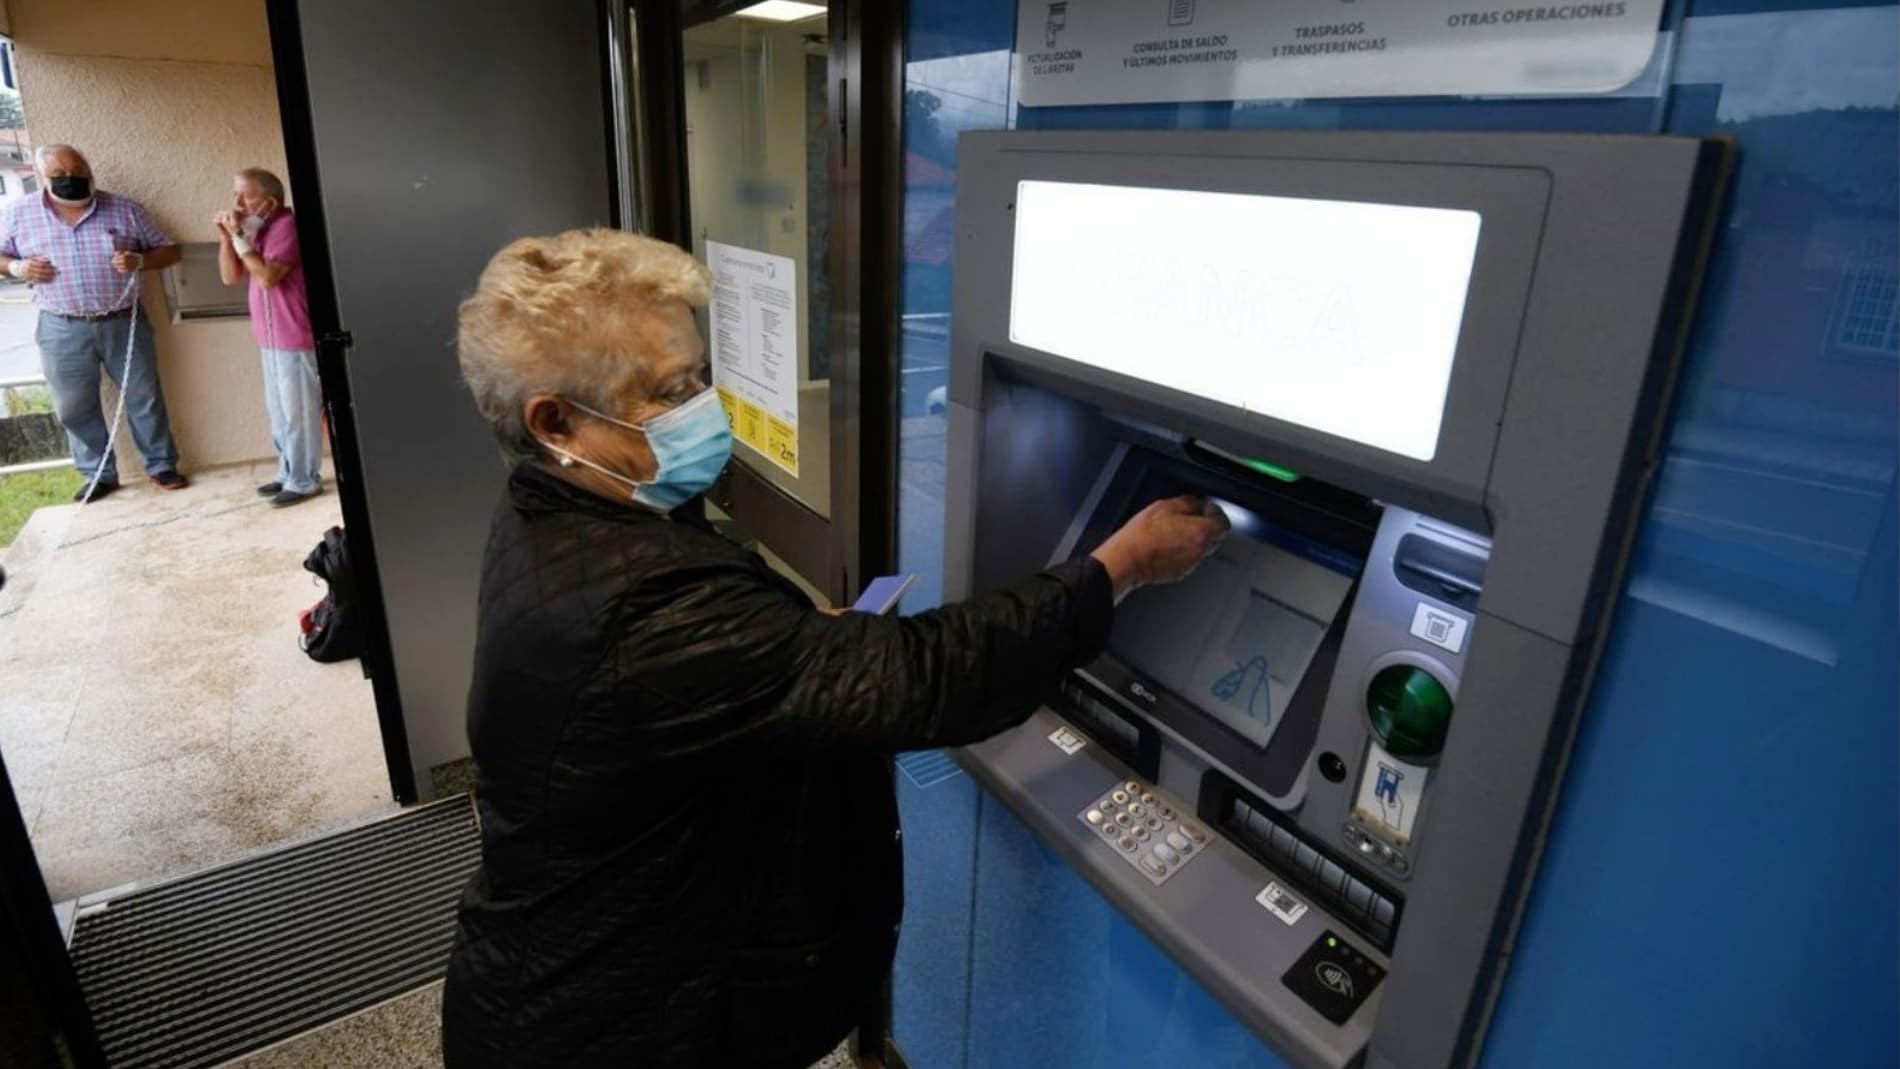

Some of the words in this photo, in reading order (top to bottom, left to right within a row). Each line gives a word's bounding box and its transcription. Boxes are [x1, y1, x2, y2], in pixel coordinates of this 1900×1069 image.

[1447, 11, 1498, 28] OTRAS
[1502, 2, 1627, 23] OPERACIONES
[1295, 21, 1365, 39] TRASPASOS
[1282, 38, 1387, 56] TRANSFERENCIAS
[1169, 49, 1237, 64] MOVIMIENTOS
